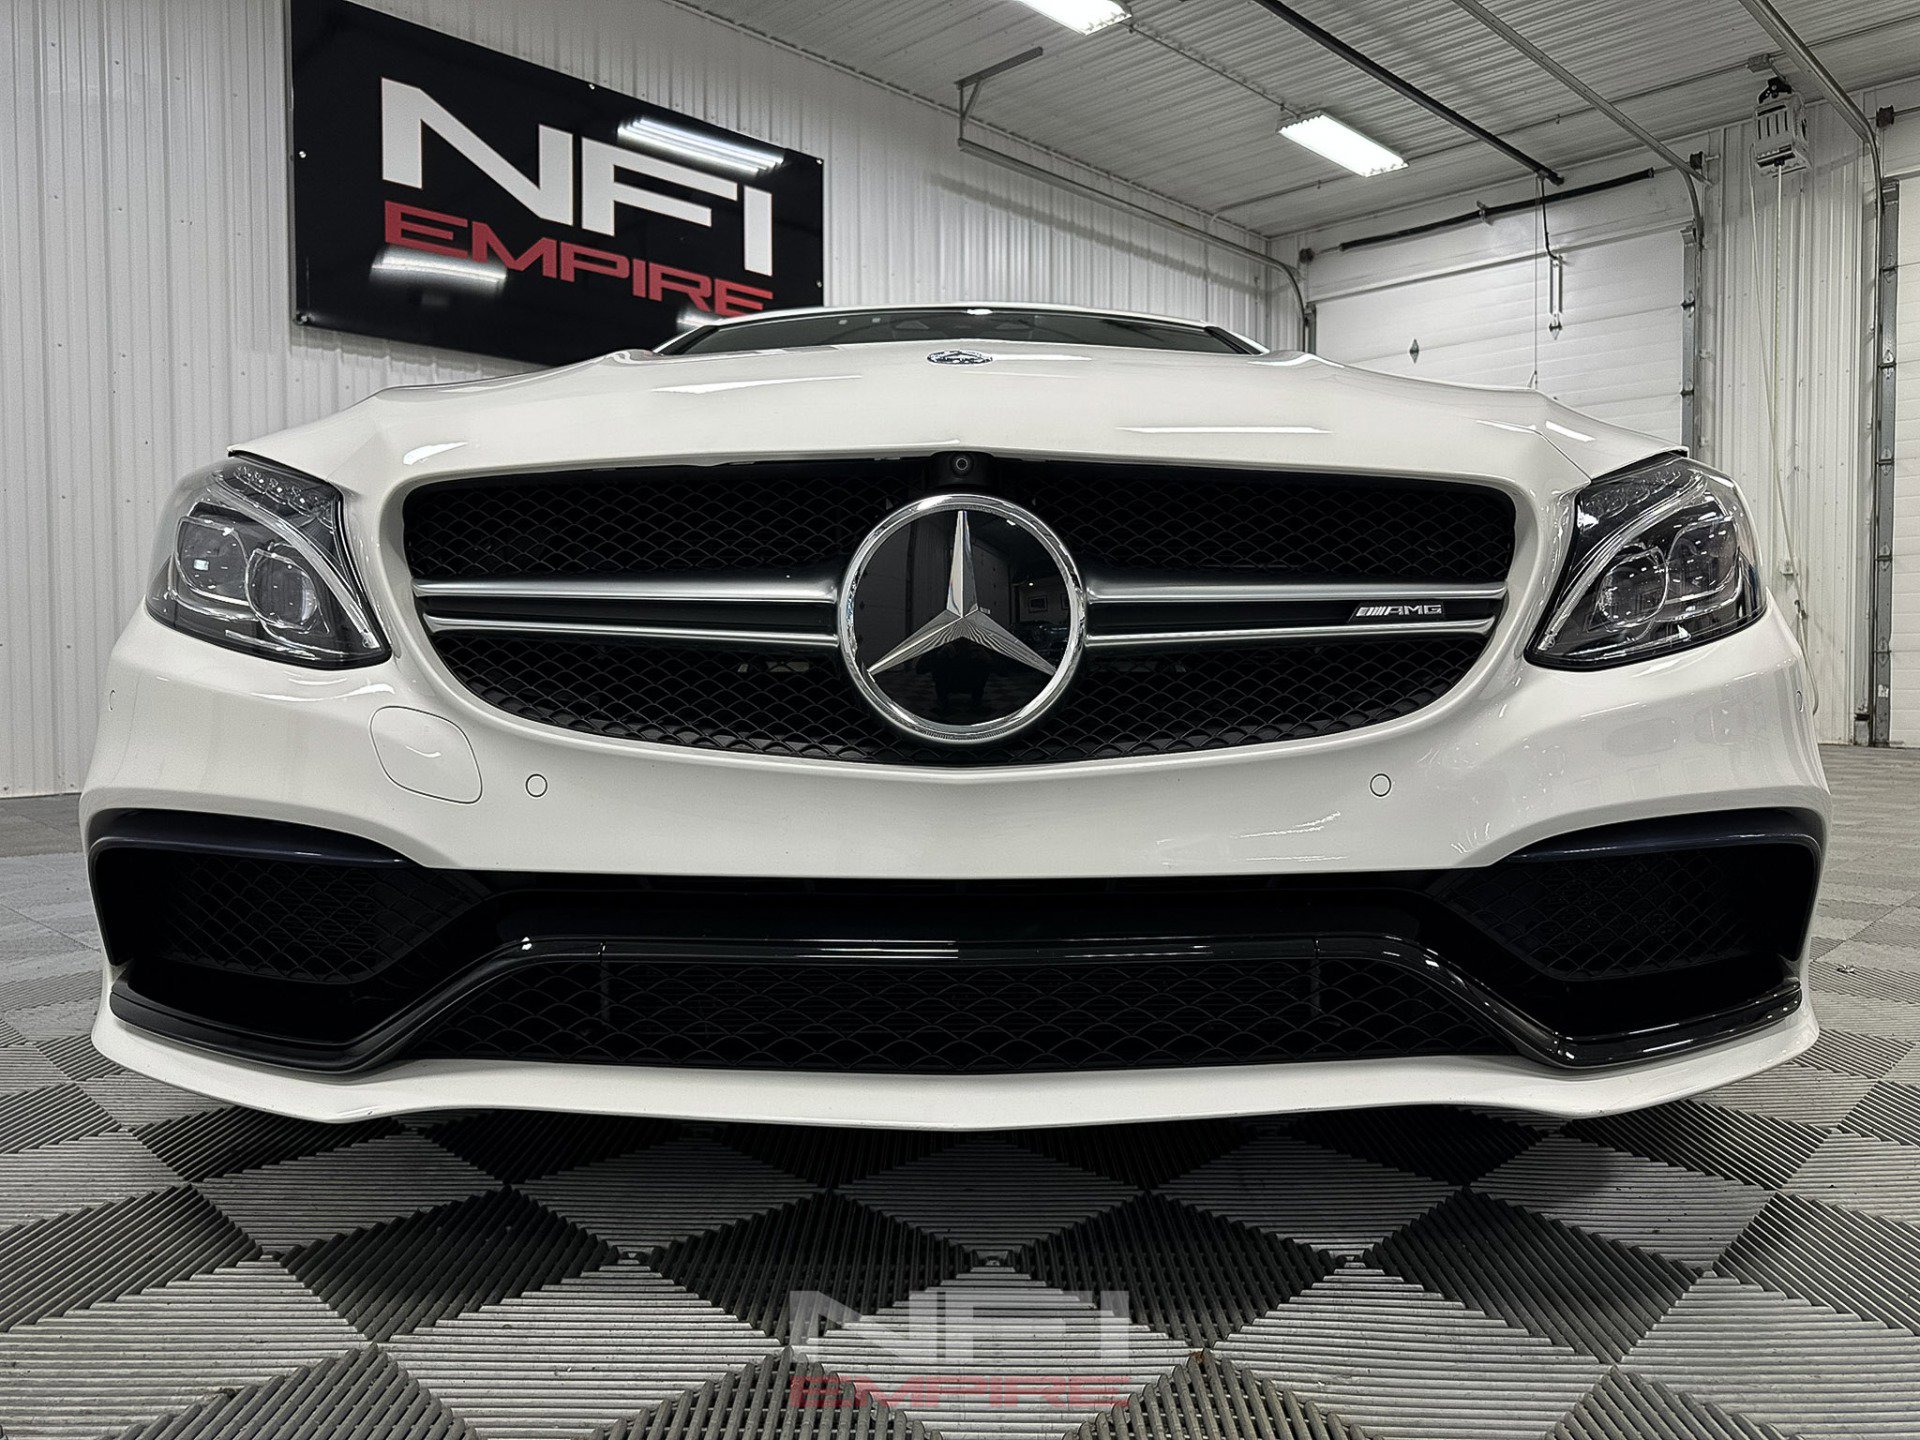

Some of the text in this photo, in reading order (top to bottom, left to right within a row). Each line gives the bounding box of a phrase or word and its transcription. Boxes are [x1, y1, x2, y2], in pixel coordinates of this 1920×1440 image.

[381, 77, 772, 276] NFI
[385, 201, 773, 317] EMPIRE
[1382, 604, 1442, 616] AMG
